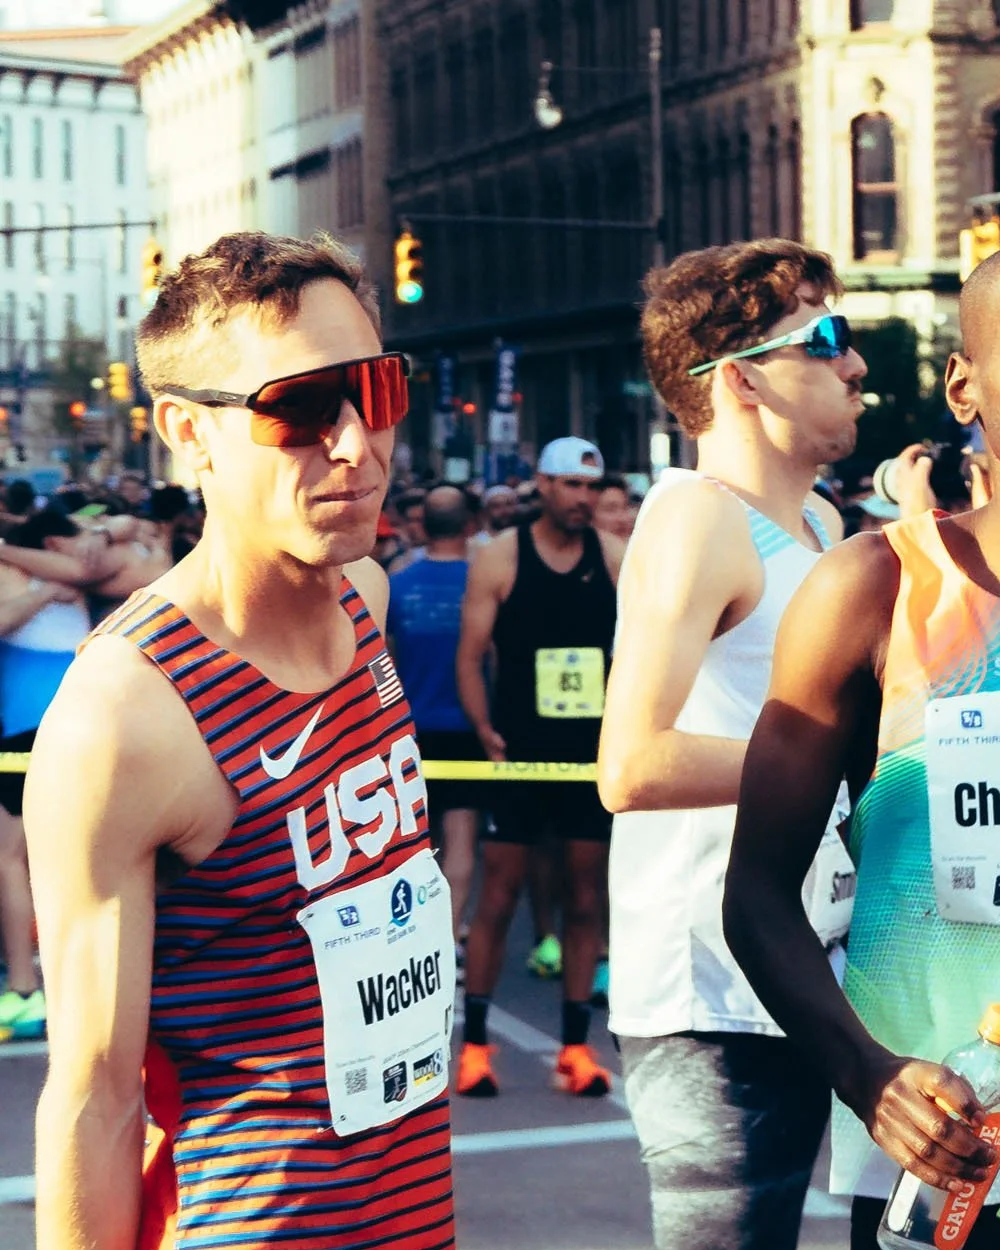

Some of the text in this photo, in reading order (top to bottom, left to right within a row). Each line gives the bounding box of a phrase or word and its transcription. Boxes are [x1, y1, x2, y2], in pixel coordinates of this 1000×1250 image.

[286, 733, 428, 891] USA
[324, 932, 352, 950] FIFTH
[353, 926, 381, 943] THIRD
[357, 949, 441, 1026] Wacker
